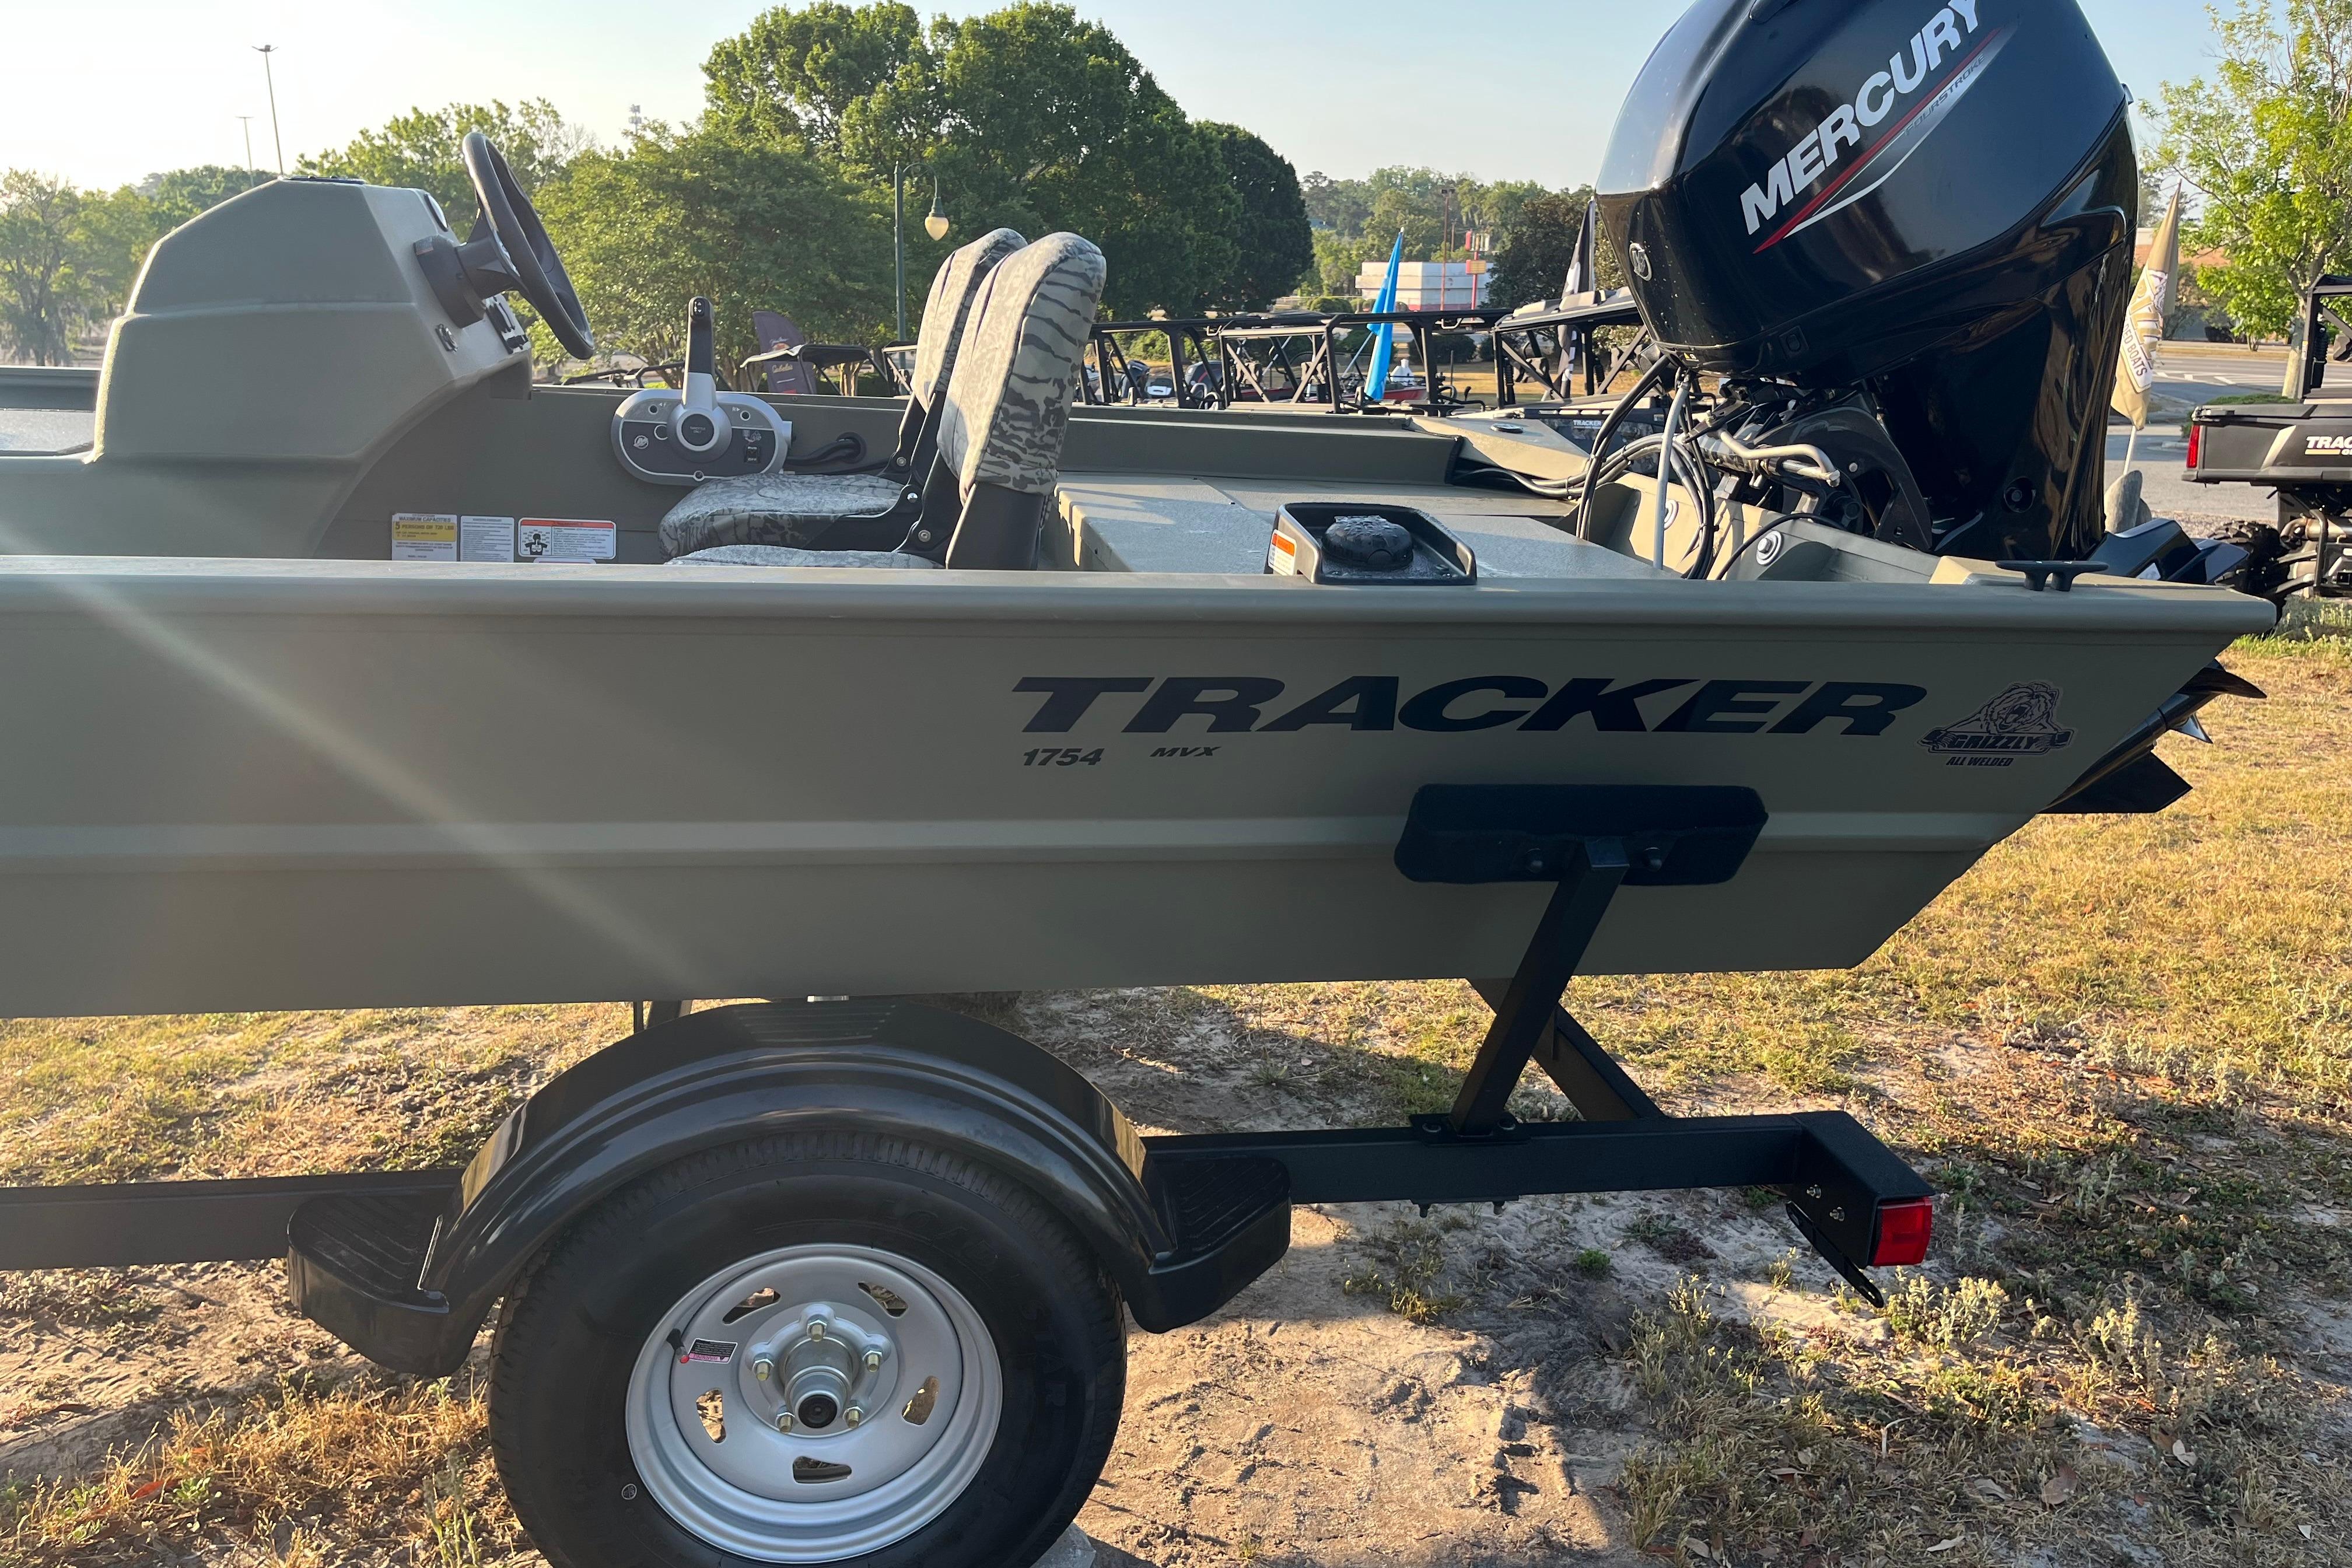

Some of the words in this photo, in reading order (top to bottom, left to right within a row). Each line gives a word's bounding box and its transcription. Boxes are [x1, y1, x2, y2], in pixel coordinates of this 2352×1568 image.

[1904, 54, 1985, 135] FOURSTROKE
[1741, 0, 1979, 235] MERCURY
[2127, 342, 2148, 377] BOATS
[1012, 676, 1927, 736] TRACKER
[1023, 748, 1104, 766] 1754
[1150, 746, 1222, 757] MVX
[1948, 734, 2038, 750] GRIZZLY
[1946, 757, 1965, 766] ALL
[1966, 757, 2014, 766] WELDED
